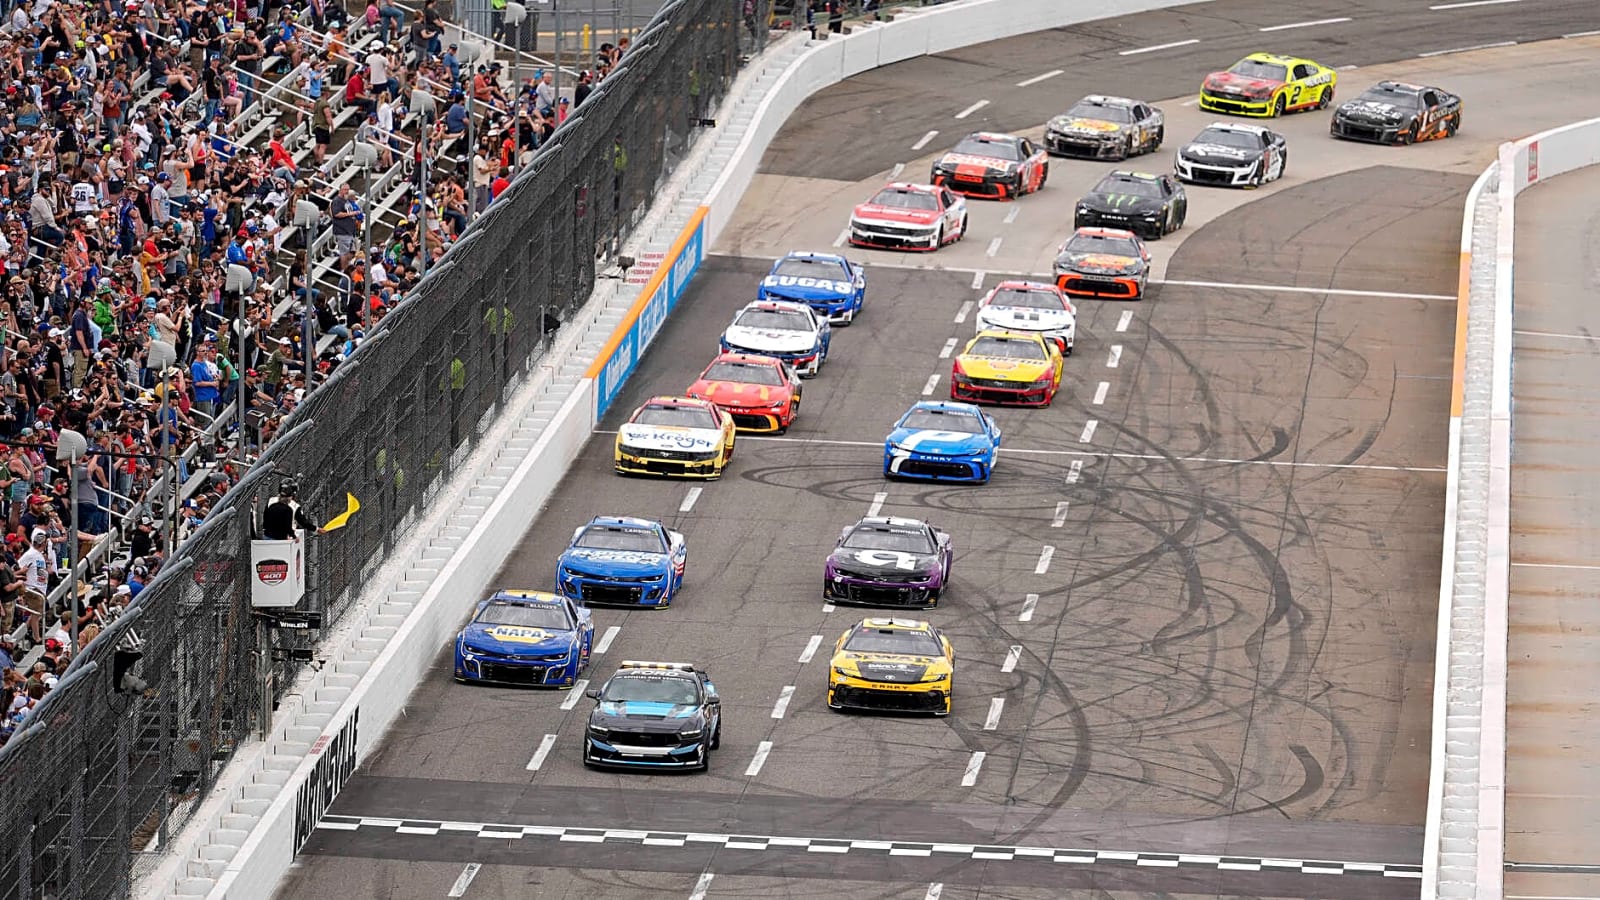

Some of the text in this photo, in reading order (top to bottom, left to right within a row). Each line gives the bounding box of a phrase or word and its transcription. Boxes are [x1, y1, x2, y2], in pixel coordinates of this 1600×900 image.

[1290, 85, 1302, 105] 2
[75, 190, 86, 202] 26
[764, 275, 853, 294] LUCAS
[652, 430, 714, 448] Kroger
[496, 627, 542, 638] NAPA
[291, 704, 360, 863] MARTINSVILLE
